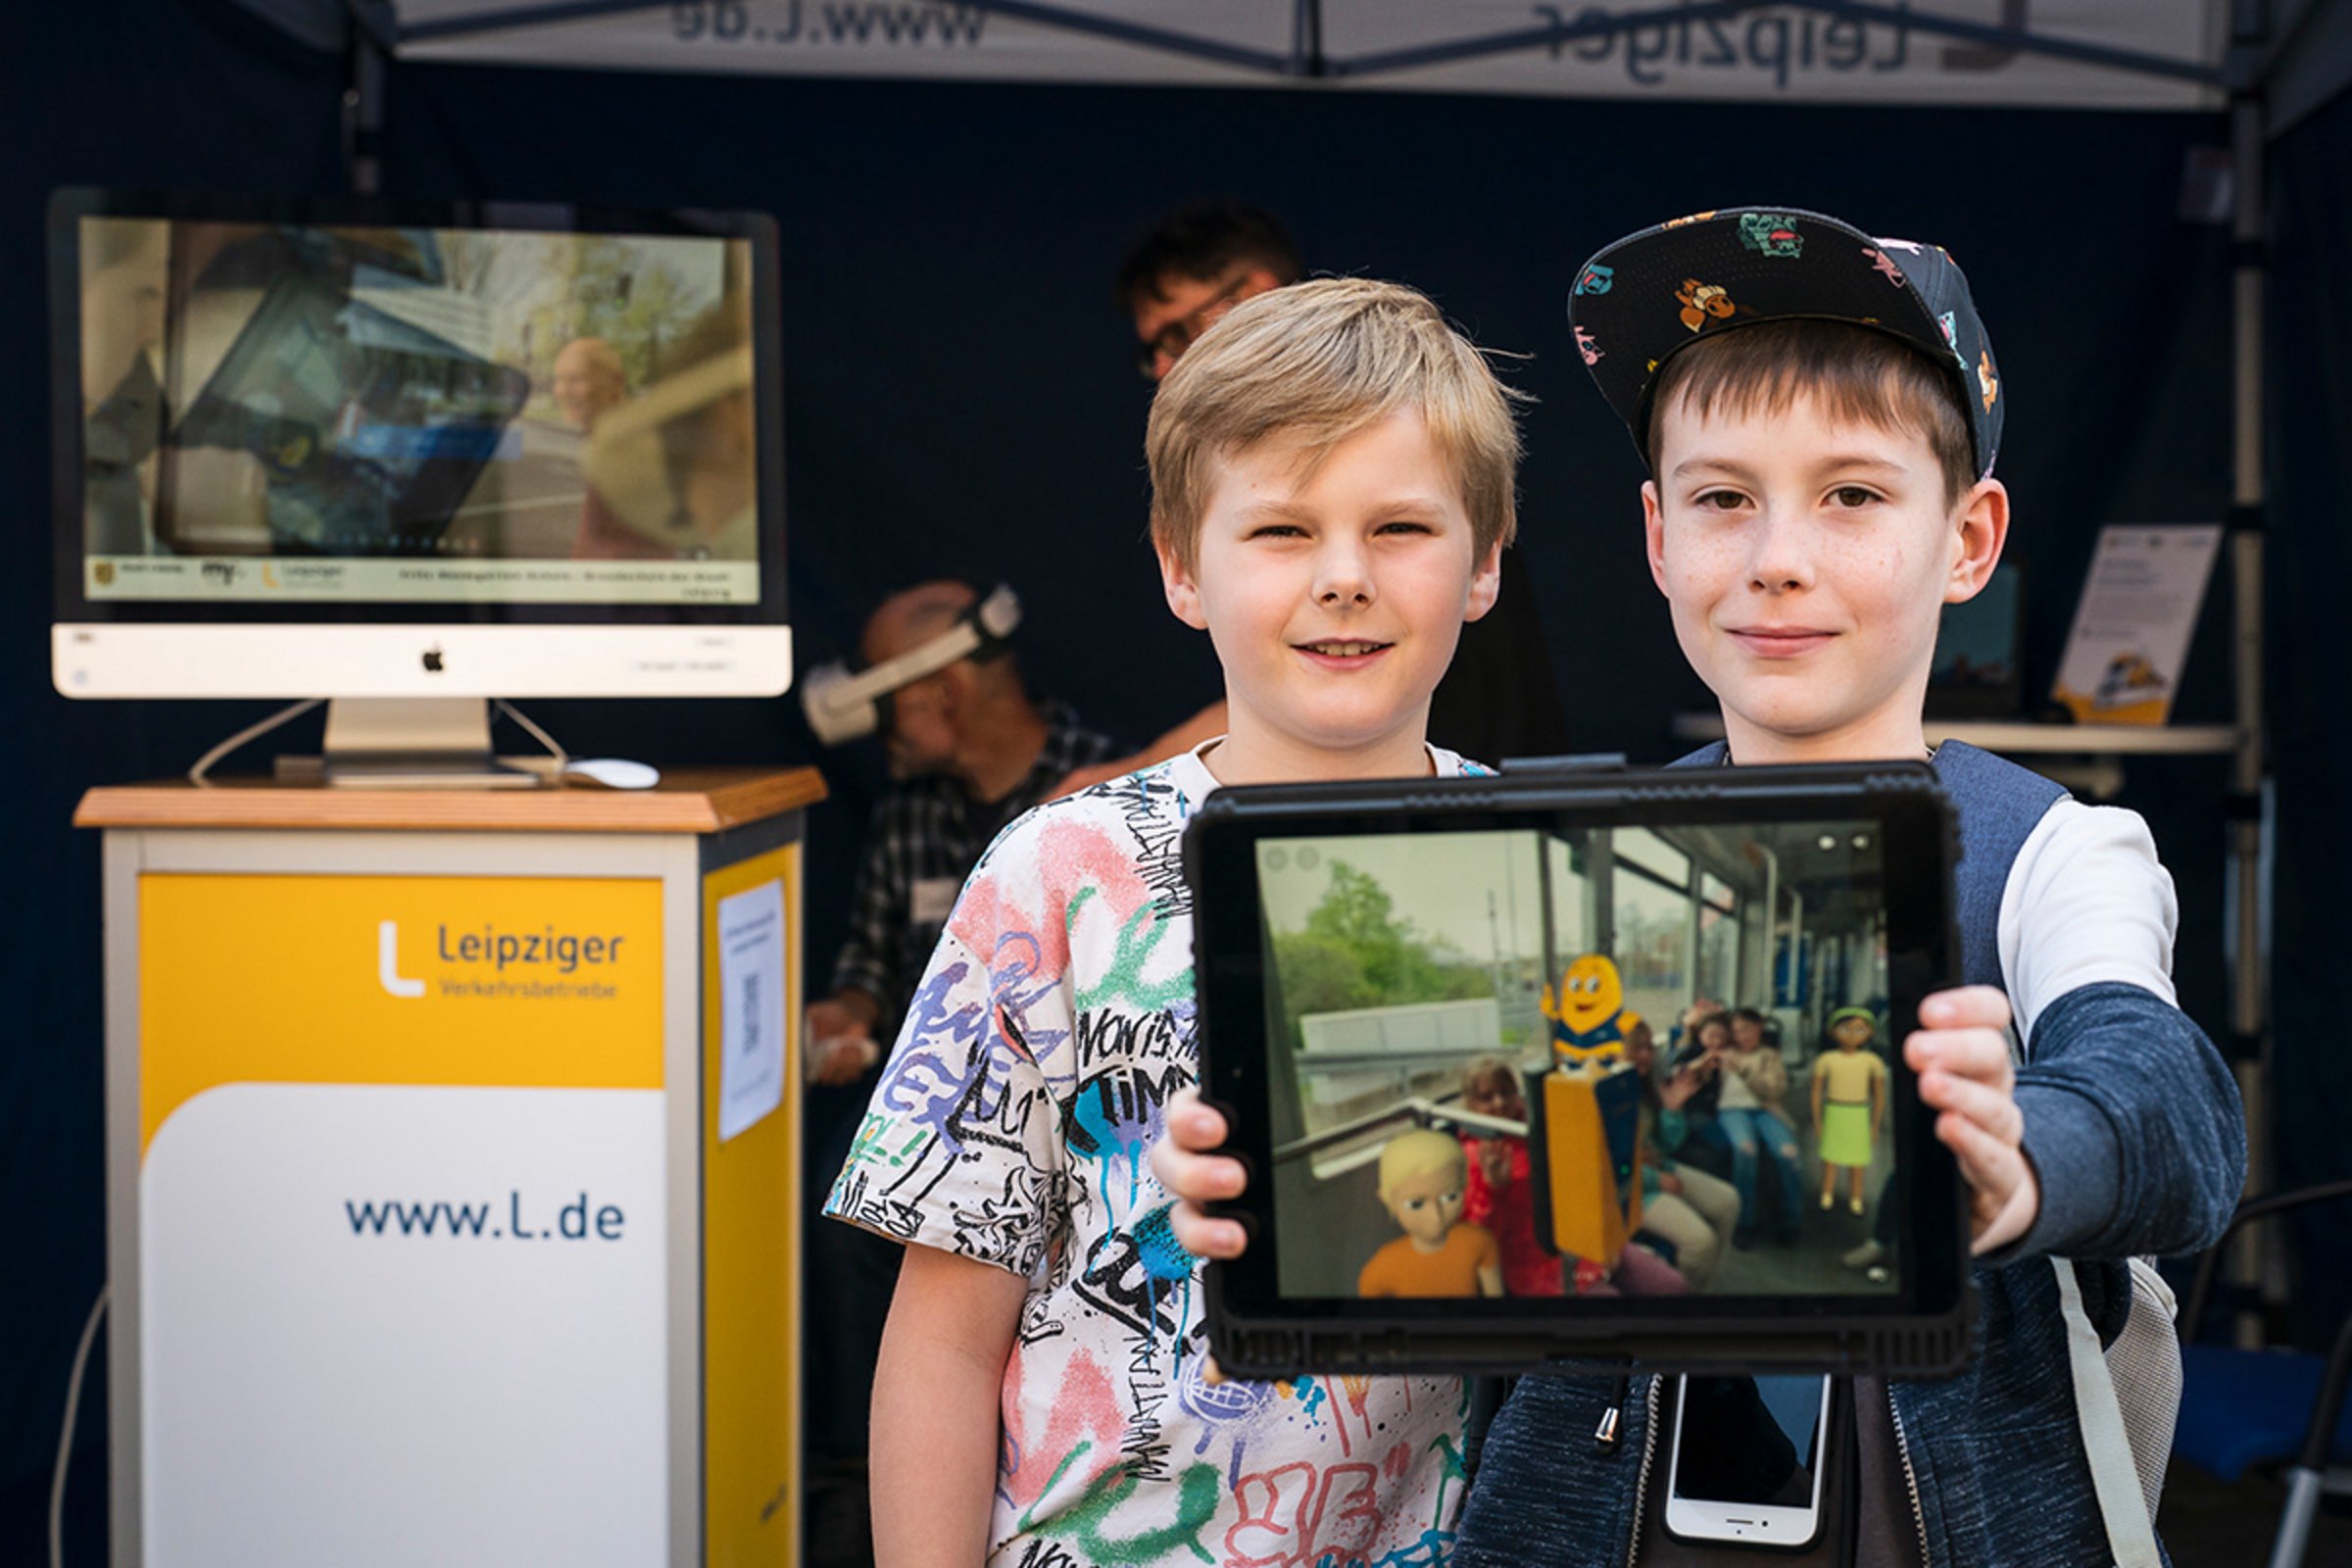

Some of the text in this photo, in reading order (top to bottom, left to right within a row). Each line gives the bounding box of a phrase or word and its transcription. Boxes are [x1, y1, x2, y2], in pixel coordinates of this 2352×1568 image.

[437, 923, 625, 974] Leipziger
[438, 978, 618, 1000] Verkehrsbetriebe
[344, 1191, 625, 1241] www.L.de
